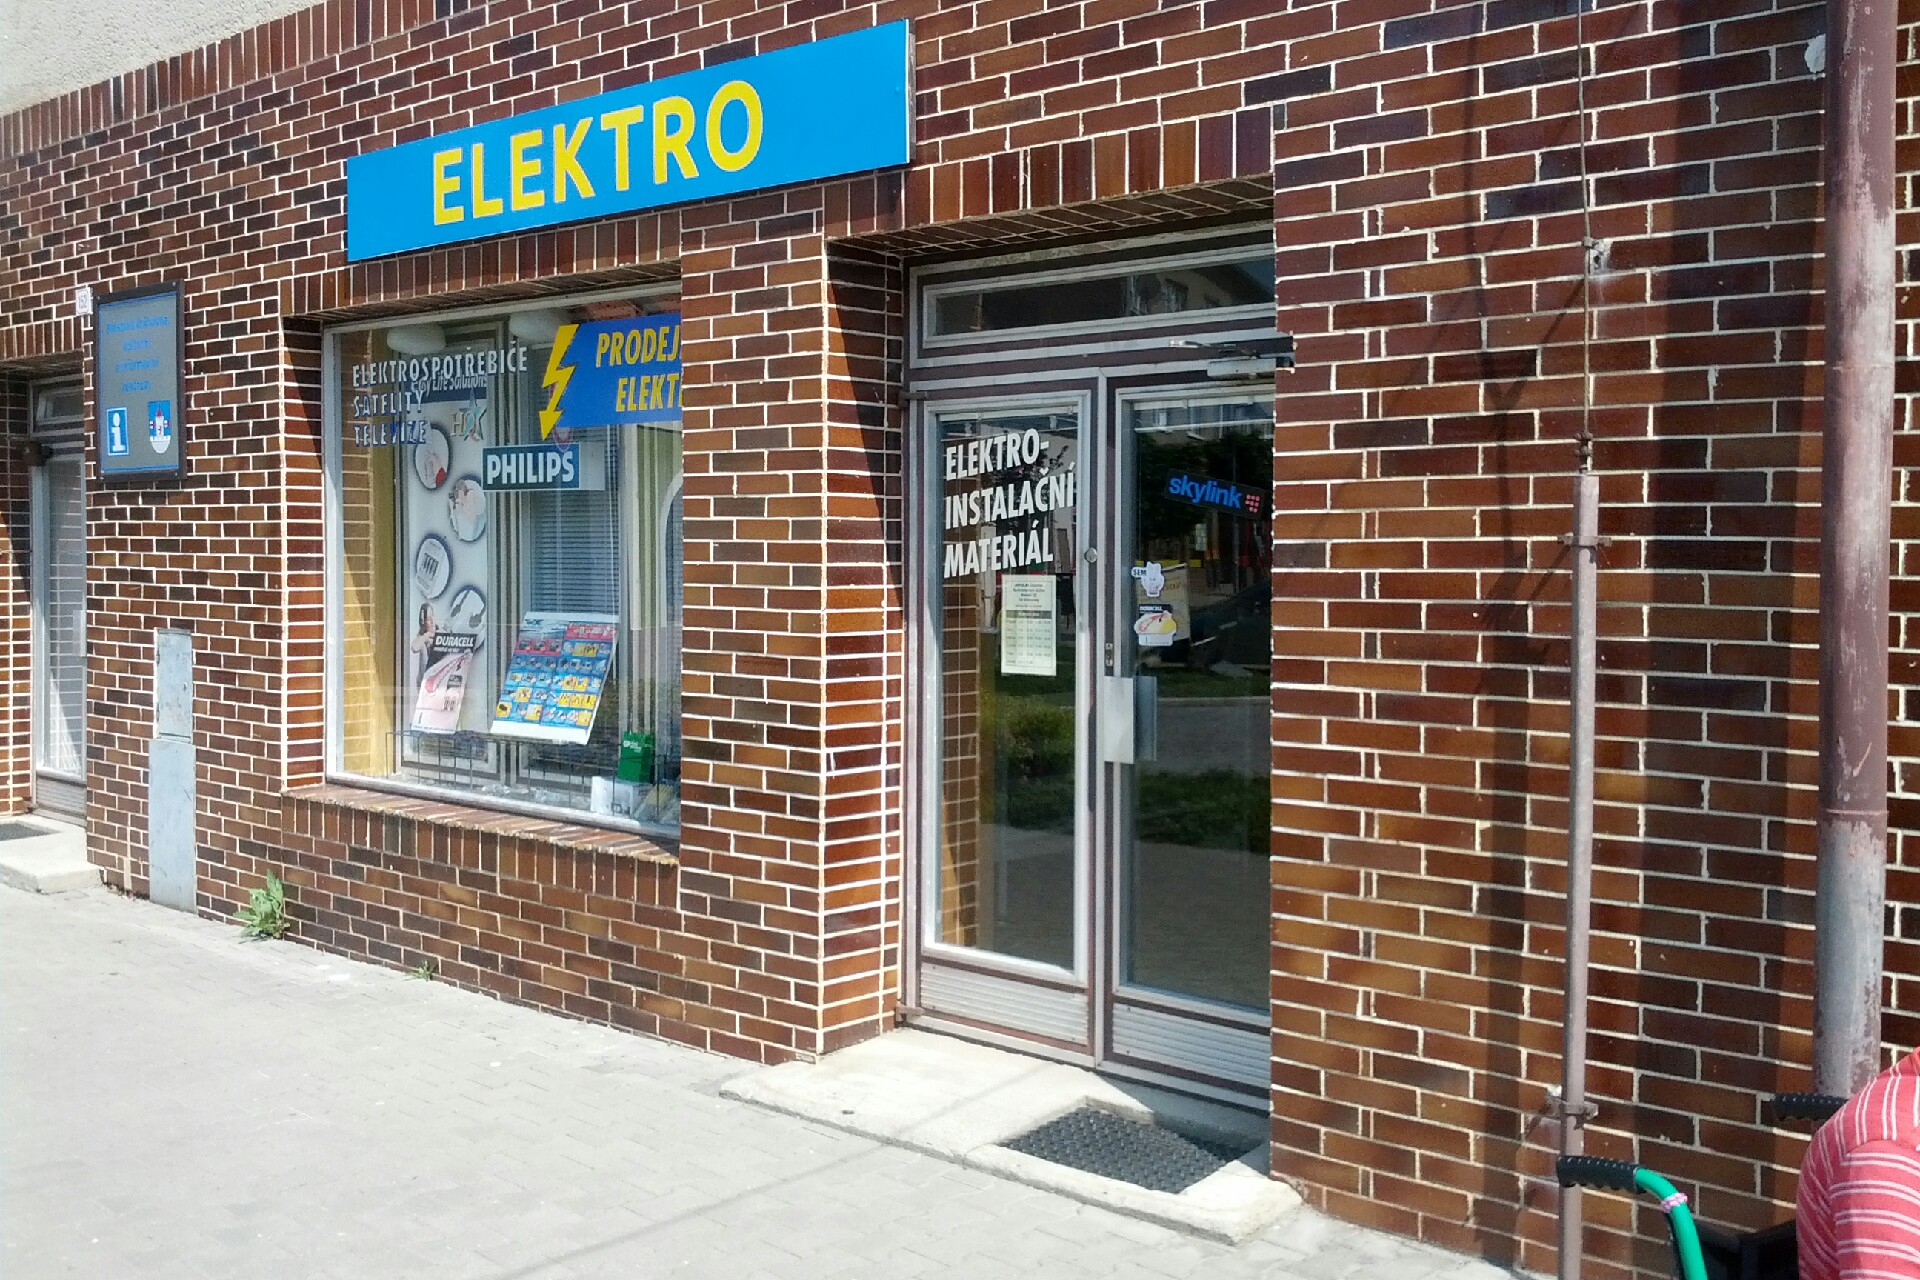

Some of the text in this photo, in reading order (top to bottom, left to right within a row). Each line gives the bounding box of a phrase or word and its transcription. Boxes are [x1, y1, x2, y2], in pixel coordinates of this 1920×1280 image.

[433, 80, 764, 226] ELEKTRO
[352, 340, 528, 388] ELEKTROSPOTŘEBIČE
[353, 389, 424, 418] SATELITY
[615, 373, 682, 412] ELEKT
[354, 420, 427, 447] TELEVIZE
[487, 451, 575, 485] PHILIPS
[946, 428, 1049, 481] ELEKTRO-
[945, 461, 1075, 530] INSTALAČNÍ
[1168, 475, 1243, 509] skylink
[944, 519, 1054, 578] MATERIÁL
[1133, 568, 1147, 576] SEM
[435, 635, 474, 647] DURACELL
